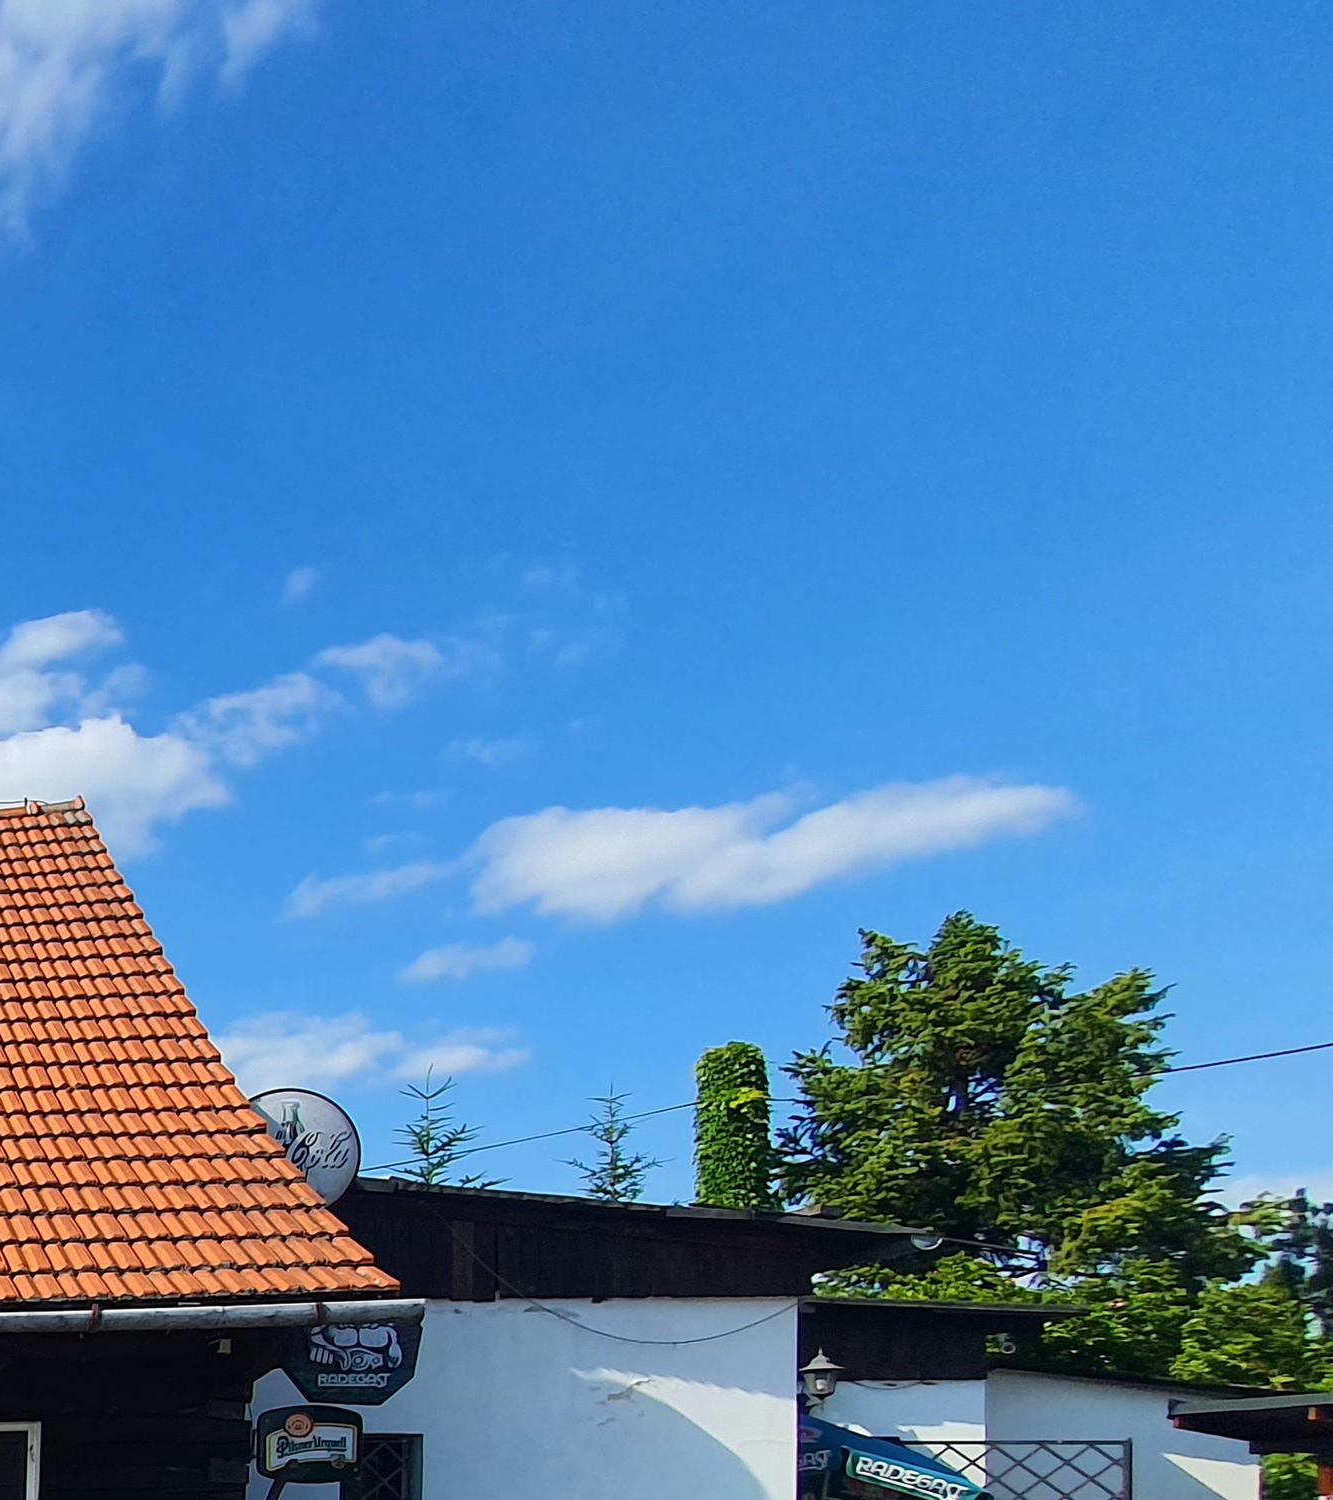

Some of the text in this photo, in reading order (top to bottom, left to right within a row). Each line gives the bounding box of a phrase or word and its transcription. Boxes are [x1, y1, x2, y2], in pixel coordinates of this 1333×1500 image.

[317, 1373, 391, 1388] RADEGAST
[276, 1436, 347, 1459] Pilsner Urquell
